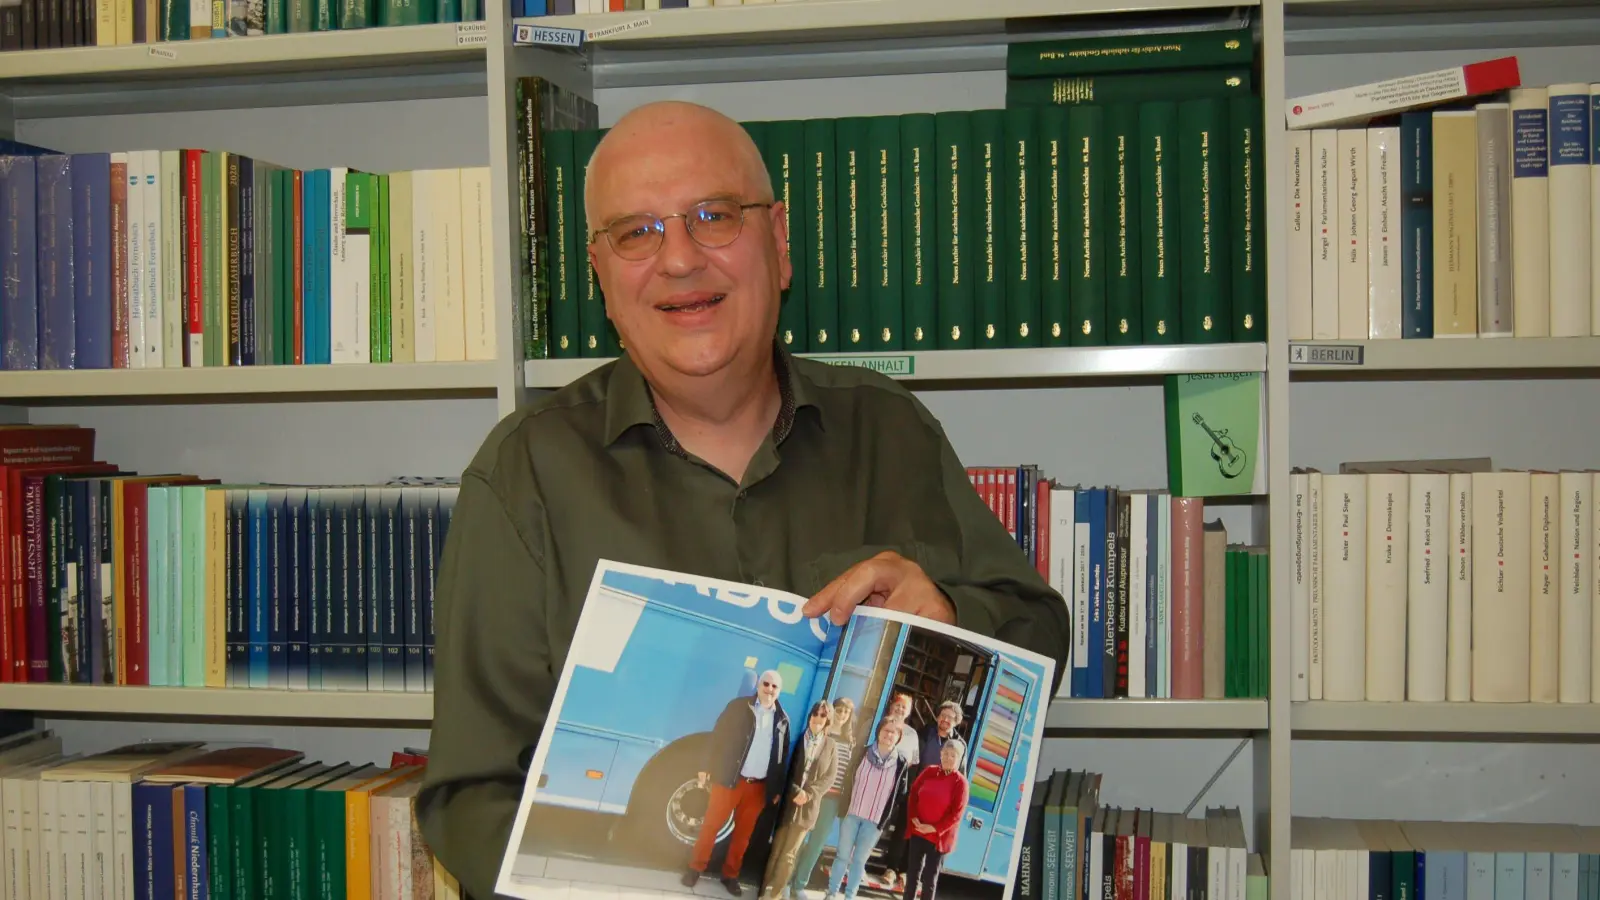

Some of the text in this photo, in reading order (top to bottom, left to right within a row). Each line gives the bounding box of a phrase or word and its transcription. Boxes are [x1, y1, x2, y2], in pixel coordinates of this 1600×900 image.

[534, 30, 575, 44] HESSEN
[594, 26, 624, 39] FRANKFURT
[634, 20, 649, 30] MAIN
[1040, 52, 1055, 60] Band
[1069, 50, 1101, 58] Geschichte
[1349, 147, 1357, 167] Wirth
[1155, 165, 1163, 197] Geschichte
[1293, 147, 1302, 231] Gallus Die Neutralisten
[1349, 168, 1359, 191] August
[1320, 148, 1330, 261] Mergel Parlamentarische Kultur
[1349, 193, 1359, 212] Georg
[528, 221, 536, 236] Über
[131, 222, 141, 318] Heimatbuch Fornsbach
[148, 222, 157, 319] Heimatbuch Fornsbach
[230, 165, 239, 344] WARTBURG-JAHRBUCH 2020
[1157, 259, 1165, 278] Neues
[1311, 350, 1354, 361] BERLIN
[1342, 493, 1351, 513] Singer
[1573, 491, 1582, 513] Region
[26, 486, 37, 578] ERNST LUDWIG
[1342, 514, 1350, 528] Paul
[1385, 493, 1394, 564] Kruke Demoskopie
[1424, 492, 1432, 584] Seefried Reich und Stände
[1497, 490, 1506, 593] Richter Deutsche Volkspartei
[1542, 496, 1551, 595] Mayer Geheime Diplomatie
[1118, 547, 1128, 589] Akupressur
[1106, 532, 1117, 656] Allerbeste Kumpels
[1118, 591, 1127, 604] und
[1118, 606, 1127, 632] Kuatsu
[1046, 830, 1057, 869] SEEWEIT
[1065, 830, 1075, 869] SEEWEIT
[1021, 846, 1031, 896] MAHNER
